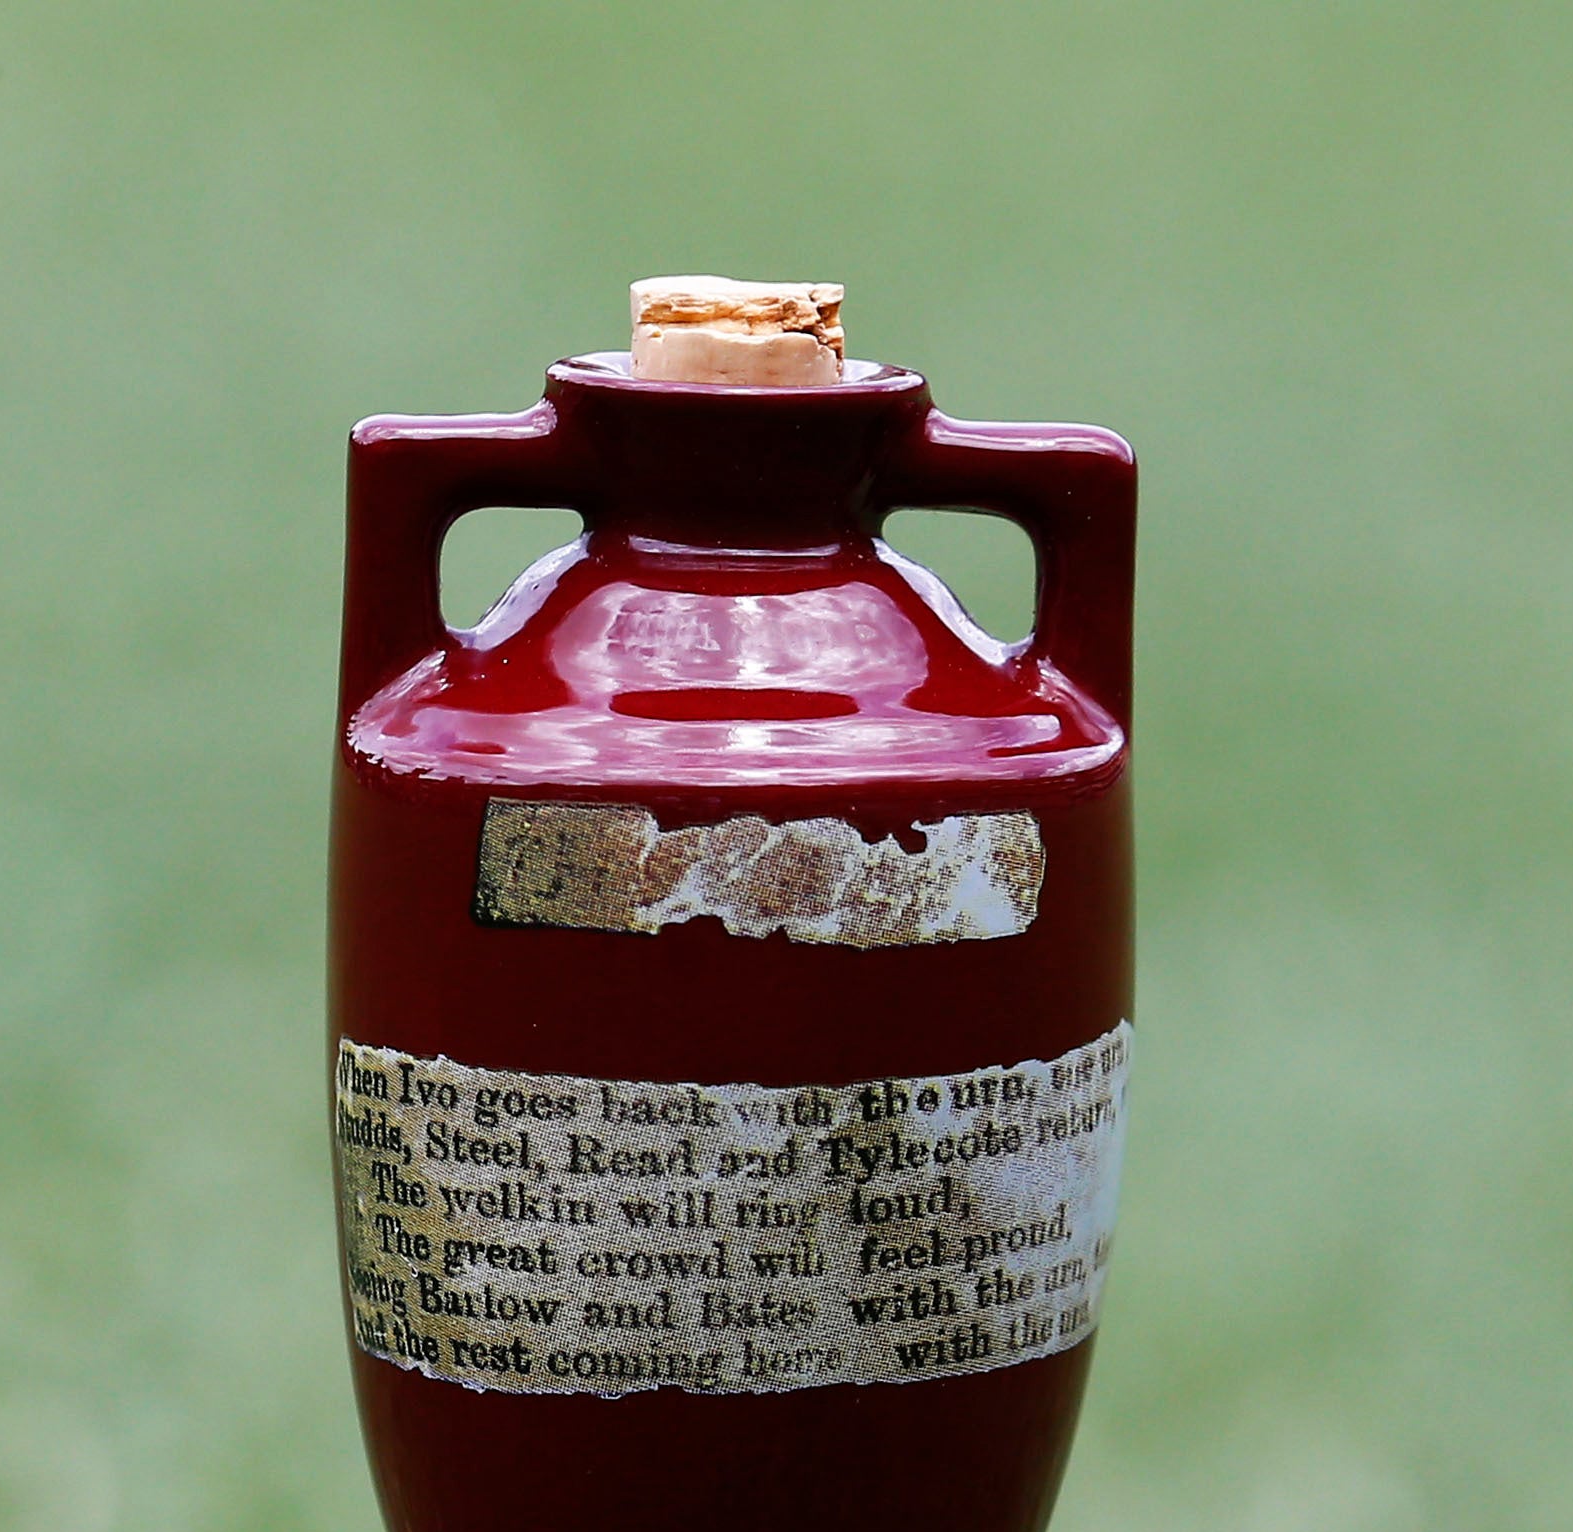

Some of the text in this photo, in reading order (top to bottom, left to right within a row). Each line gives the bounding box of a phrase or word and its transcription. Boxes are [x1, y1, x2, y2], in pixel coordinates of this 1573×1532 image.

[340, 1050, 389, 1101] When
[398, 1062, 458, 1109] Ivo
[475, 1085, 577, 1128] goes
[861, 1083, 941, 1122] the
[426, 1120, 545, 1179] Steel,
[568, 1133, 700, 1178] Read
[718, 1139, 796, 1178] and
[819, 1120, 1024, 1184] Tylecote
[372, 1159, 428, 1209] The
[439, 1182, 596, 1226] welkin
[618, 1190, 715, 1229] will
[374, 1213, 431, 1261] The
[442, 1236, 558, 1279] great
[577, 1240, 733, 1279] crowd
[860, 1228, 942, 1276] feel
[419, 1271, 563, 1327] Barlow
[582, 1290, 677, 1330] and
[848, 1278, 959, 1326] with
[974, 1266, 1036, 1306] the
[392, 1318, 441, 1364] the
[449, 1335, 534, 1376] rest
[546, 1340, 728, 1388] coming
[893, 1322, 993, 1370] with
